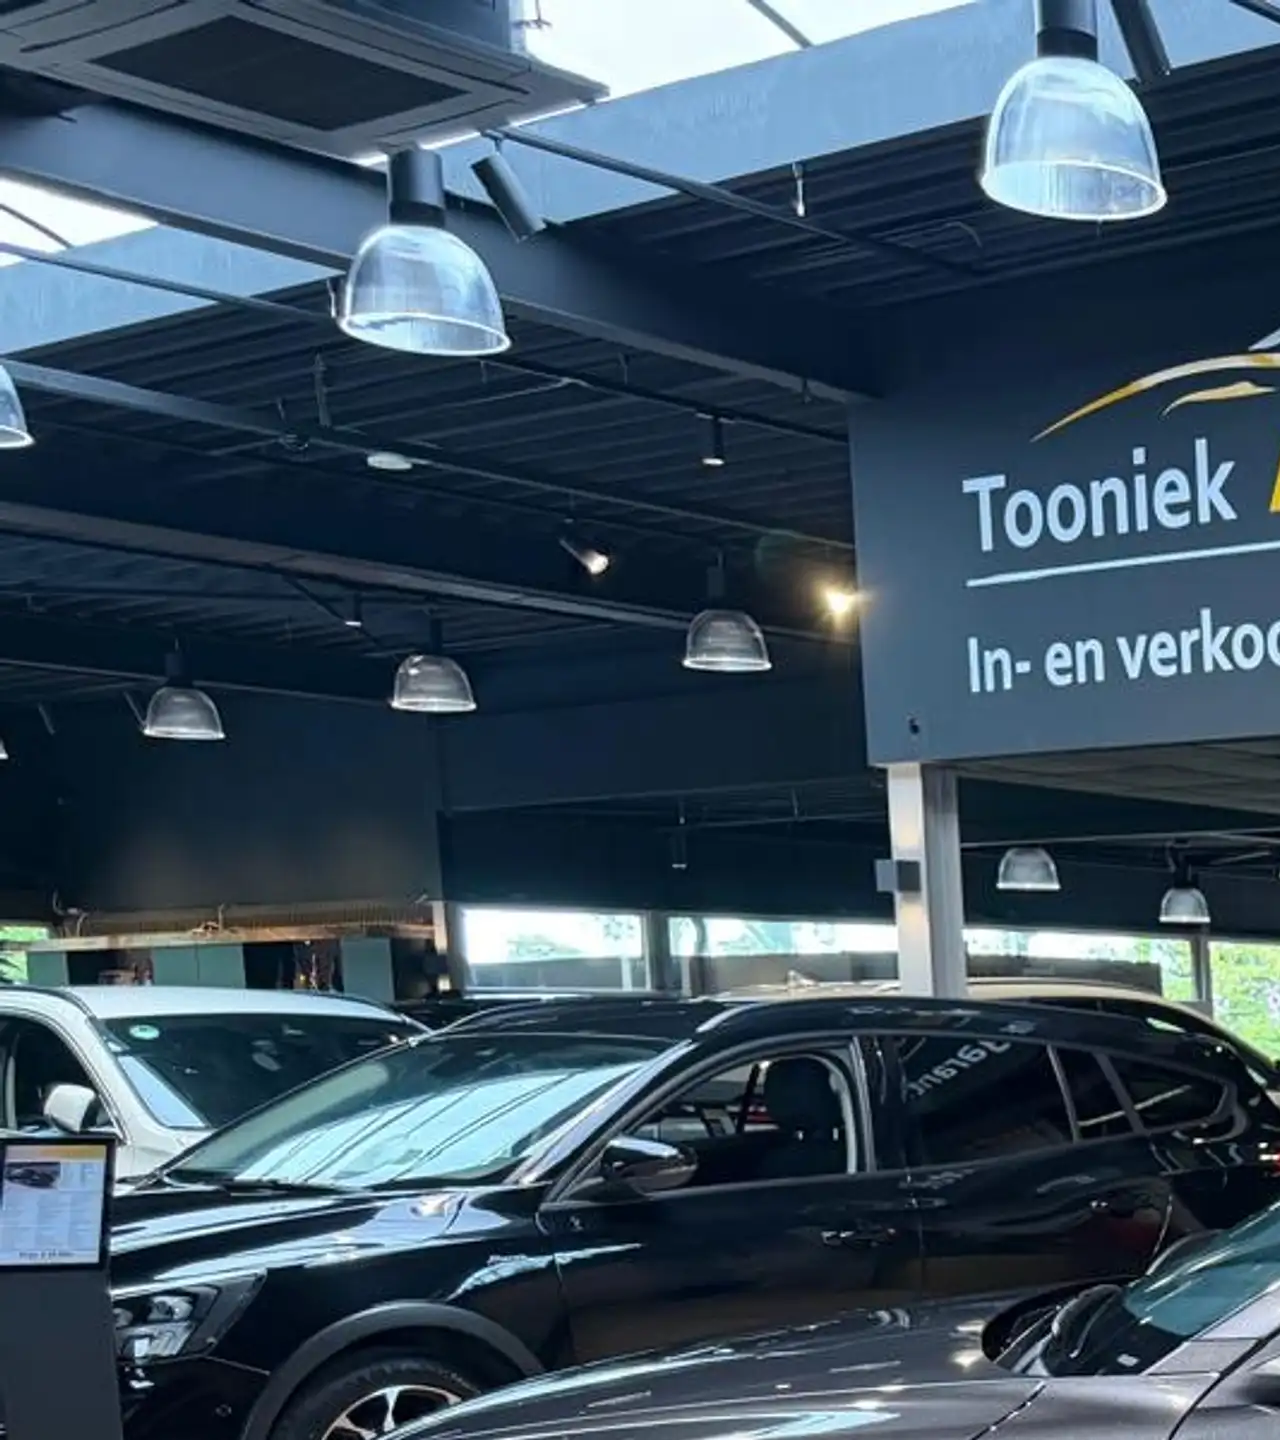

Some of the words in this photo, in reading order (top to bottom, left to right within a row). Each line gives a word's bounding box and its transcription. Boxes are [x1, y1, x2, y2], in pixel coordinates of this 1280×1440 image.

[961, 437, 1238, 553] Tooniek
[967, 636, 1032, 694] In-
[1044, 638, 1106, 688] en
